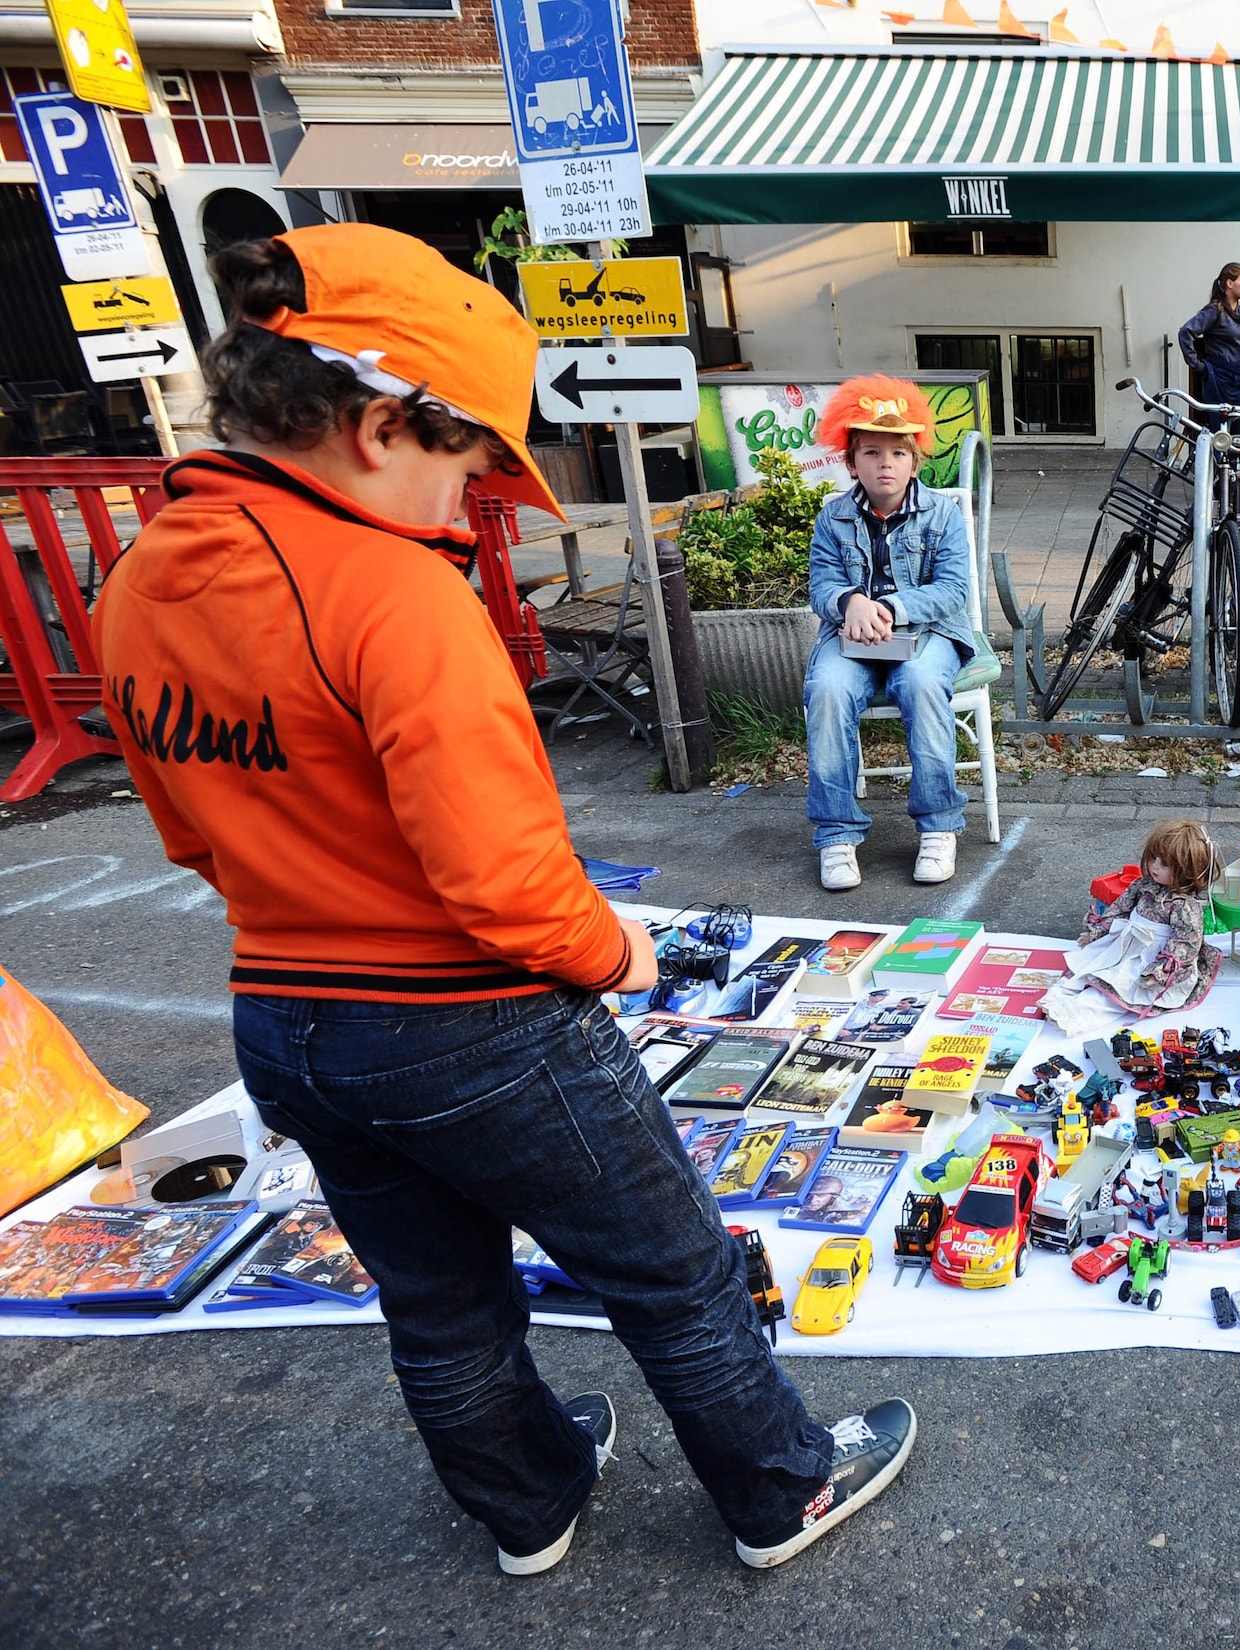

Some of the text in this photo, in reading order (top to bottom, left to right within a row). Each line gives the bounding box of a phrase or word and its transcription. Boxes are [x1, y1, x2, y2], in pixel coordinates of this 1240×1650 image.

[36, 106, 89, 175] P
[563, 159, 613, 177] 26-04-'11
[545, 179, 615, 198] t/m 02-05-'11
[560, 197, 638, 217] 29-04-'11 10h
[544, 217, 641, 237] t/m 30-04-'11 23h
[535, 311, 678, 331] wegsleepregeling
[735, 408, 817, 468] Grol
[975, 1013, 1039, 1028] BEN ZUIDEMA
[802, 1039, 872, 1060] BEN ZUIDEMA
[928, 1044, 986, 1055] SHELDON
[939, 1036, 984, 1046] SIDNEY
[930, 1080, 961, 1088] ANGELS
[755, 1099, 828, 1113] LEON ZOETEMAN
[986, 1160, 1016, 1172] 138
[951, 1241, 996, 1256] RACING
[833, 1465, 856, 1482] sportif
[804, 1484, 836, 1513] le coq
[803, 1496, 835, 1523] sportif
